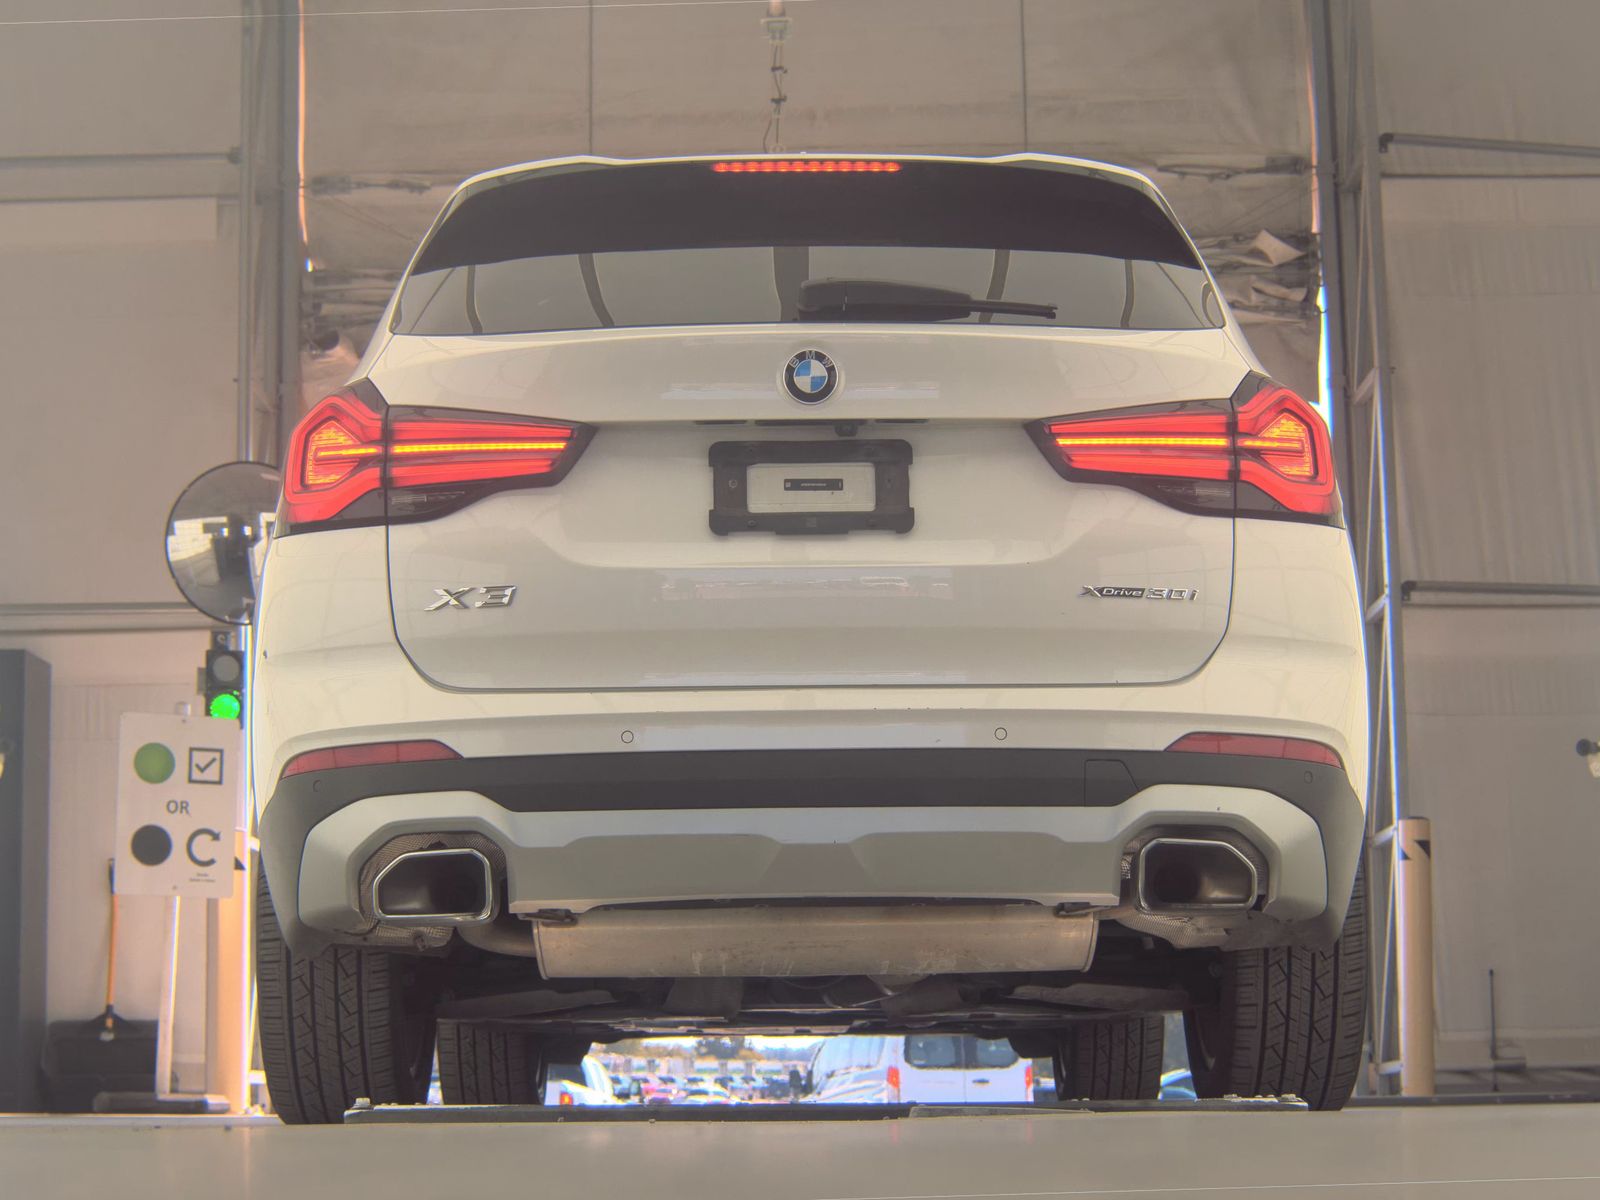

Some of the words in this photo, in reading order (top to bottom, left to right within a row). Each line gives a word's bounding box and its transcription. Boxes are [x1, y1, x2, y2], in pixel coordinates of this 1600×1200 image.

[788, 350, 834, 368] BMW
[423, 585, 516, 611] X3
[166, 799, 190, 815] OR
